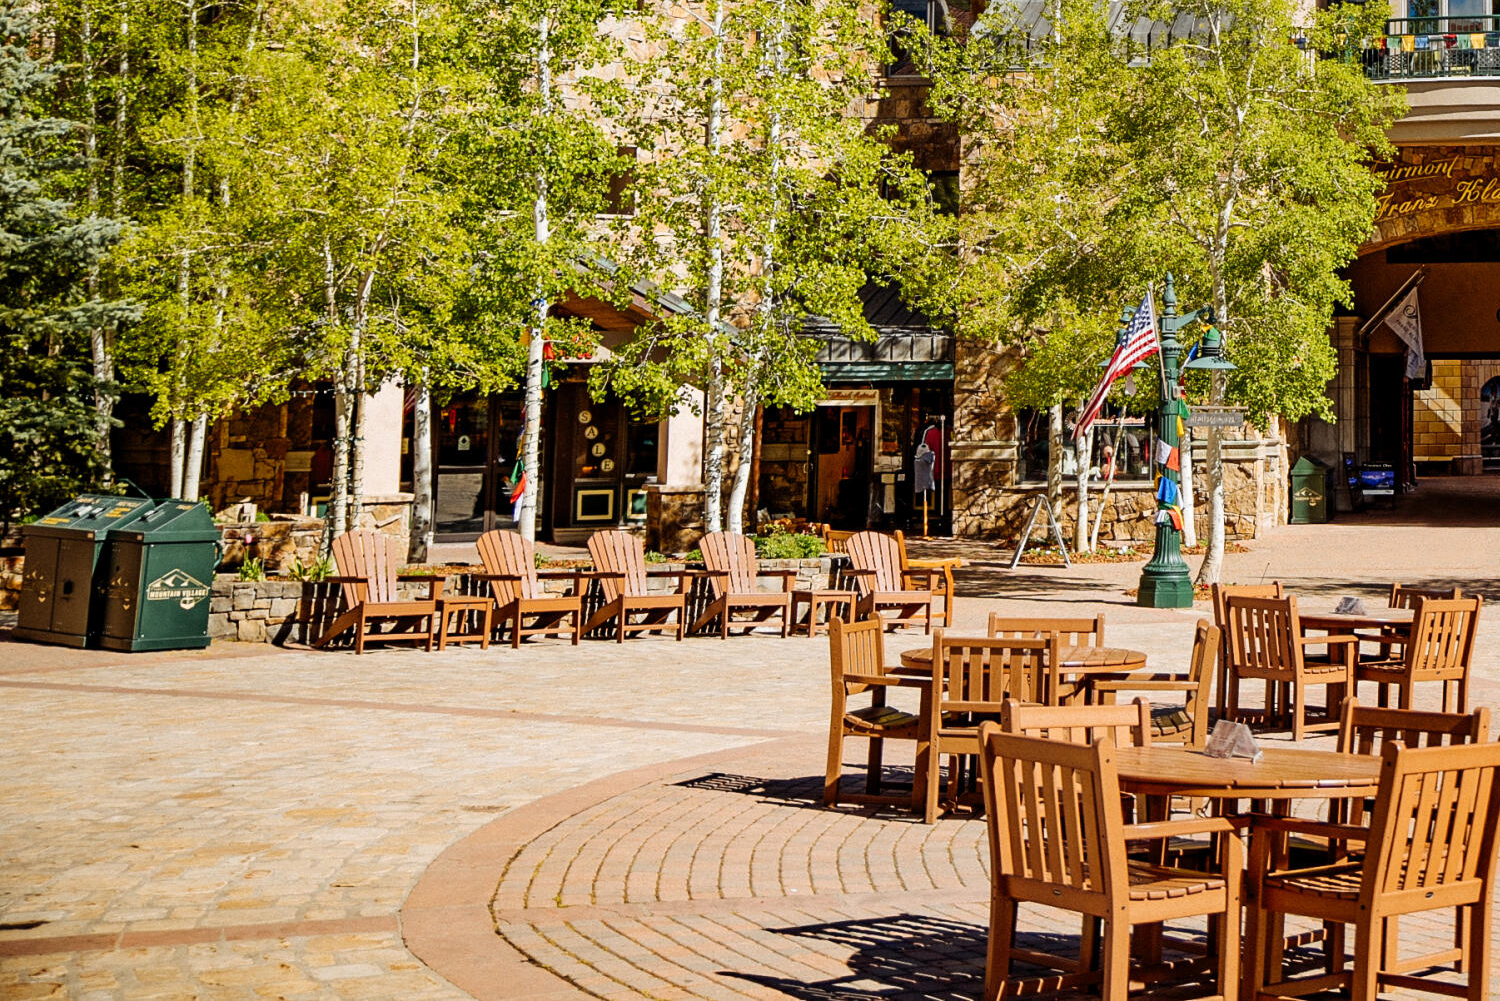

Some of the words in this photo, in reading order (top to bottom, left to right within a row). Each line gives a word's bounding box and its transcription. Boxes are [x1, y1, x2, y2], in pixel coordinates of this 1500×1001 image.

[1374, 192, 1439, 221] Franz
[580, 411, 612, 471] SALE
[150, 590, 181, 598] MOUNTAIN
[182, 589, 208, 597] VILLAGE
